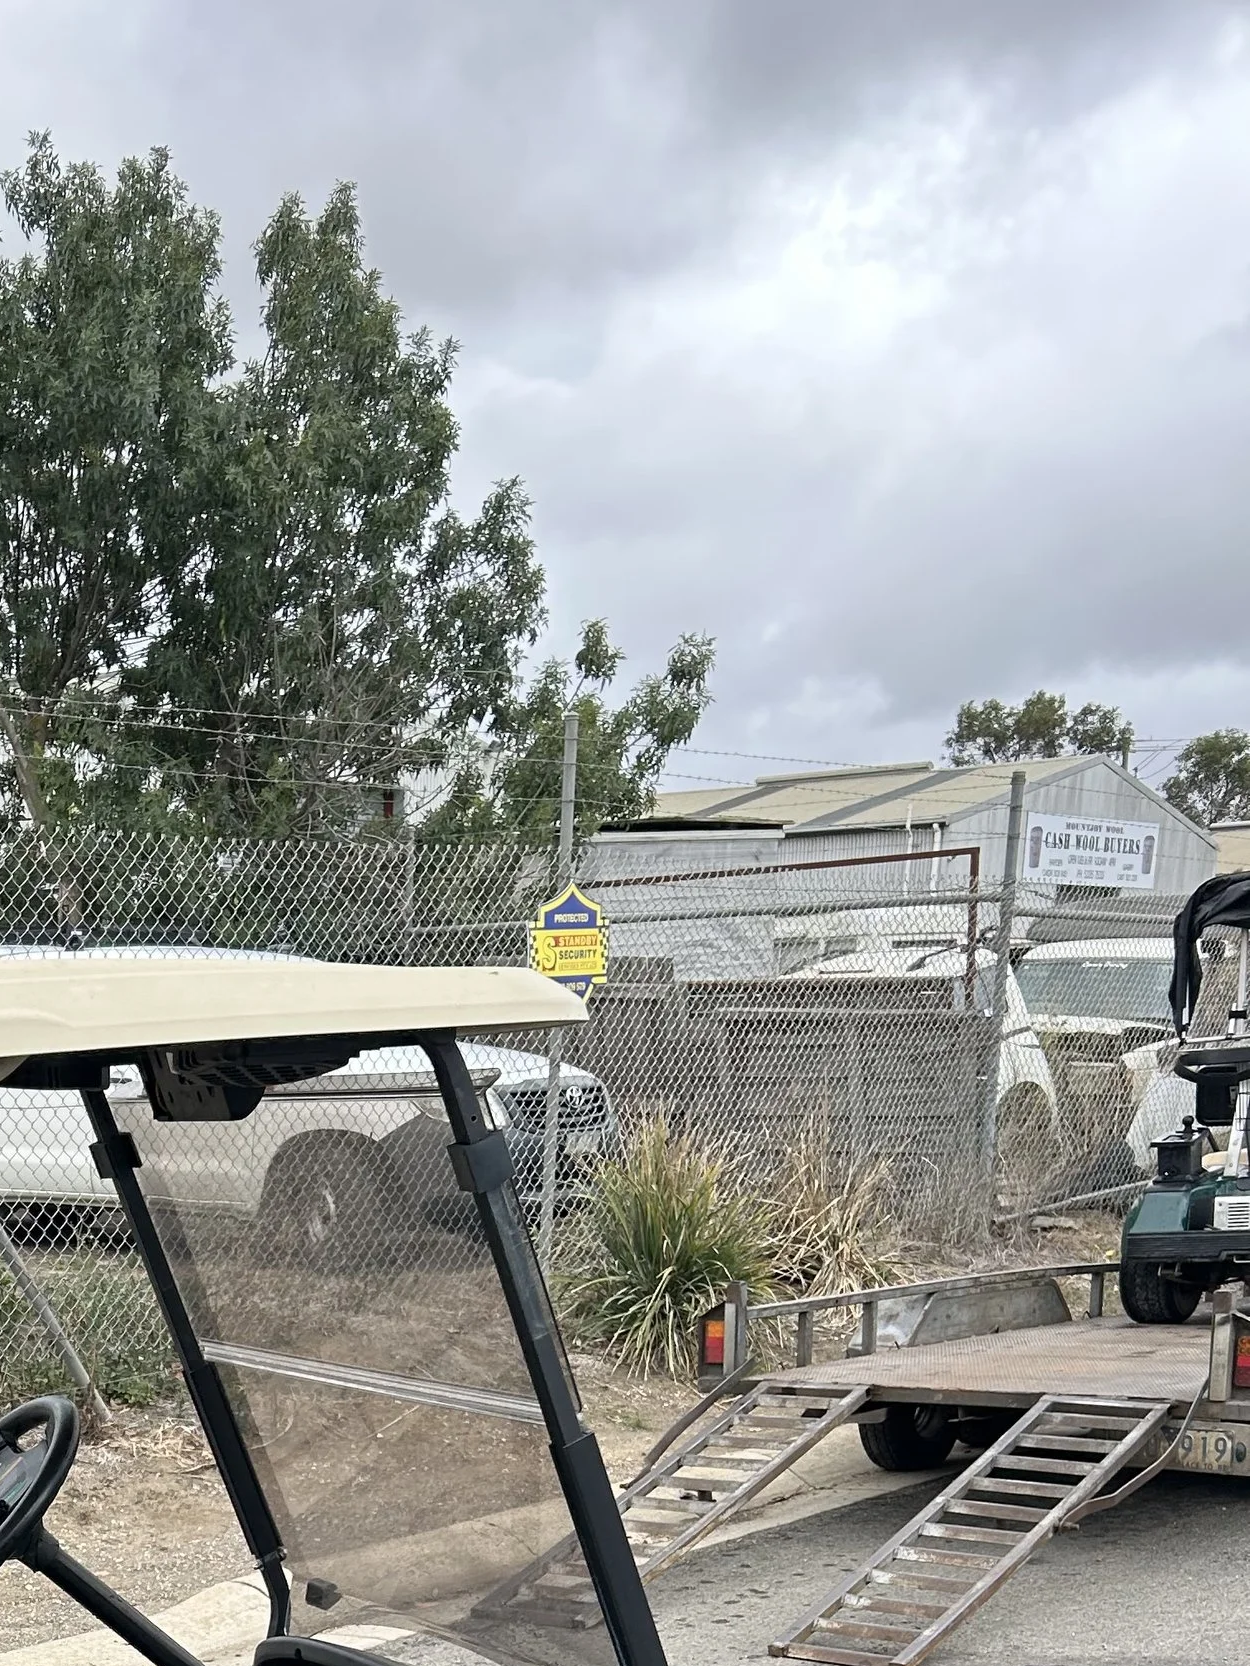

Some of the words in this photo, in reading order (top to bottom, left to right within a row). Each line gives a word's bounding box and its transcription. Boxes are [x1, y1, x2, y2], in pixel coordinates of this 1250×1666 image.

[1106, 825, 1124, 834] WOOL
[1045, 832, 1071, 850] CASH
[1075, 834, 1100, 853] WOOL
[1103, 835, 1141, 855] BUYERS
[558, 935, 597, 947] STANDBY
[558, 949, 597, 960] SECURITY
